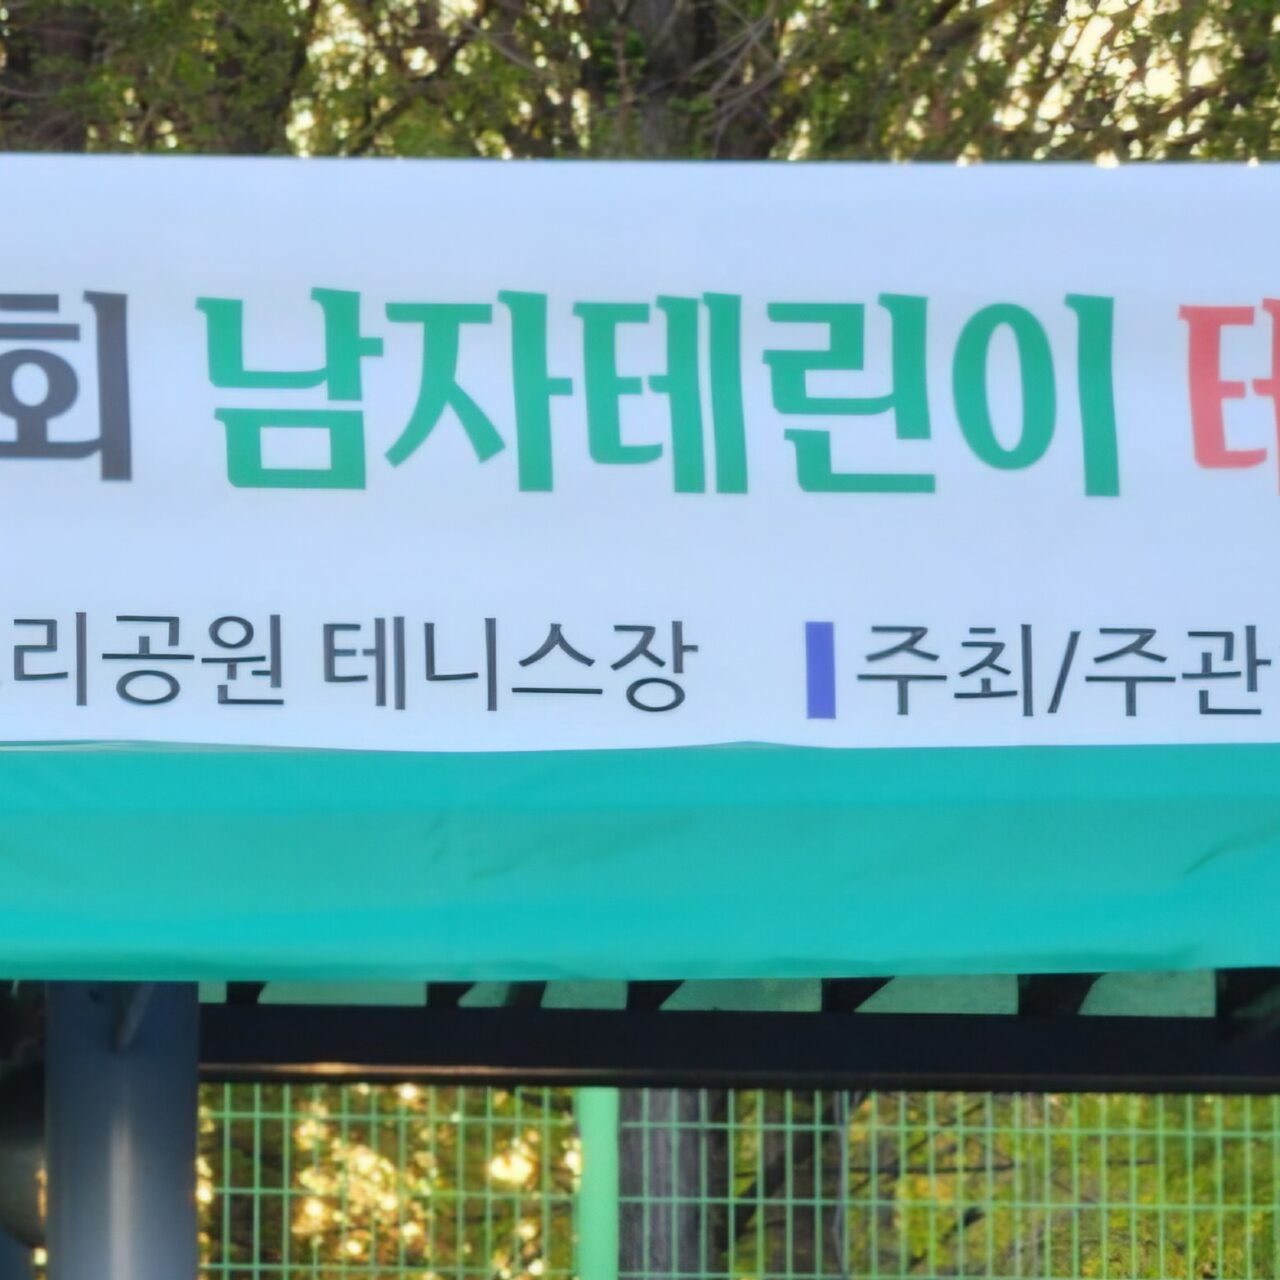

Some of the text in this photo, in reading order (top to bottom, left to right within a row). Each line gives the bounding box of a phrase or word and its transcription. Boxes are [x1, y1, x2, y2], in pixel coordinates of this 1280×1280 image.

[194, 286, 1120, 498] 남자테린이
[322, 616, 699, 714] 테니스장
[855, 623, 1273, 718] 주최/주관
